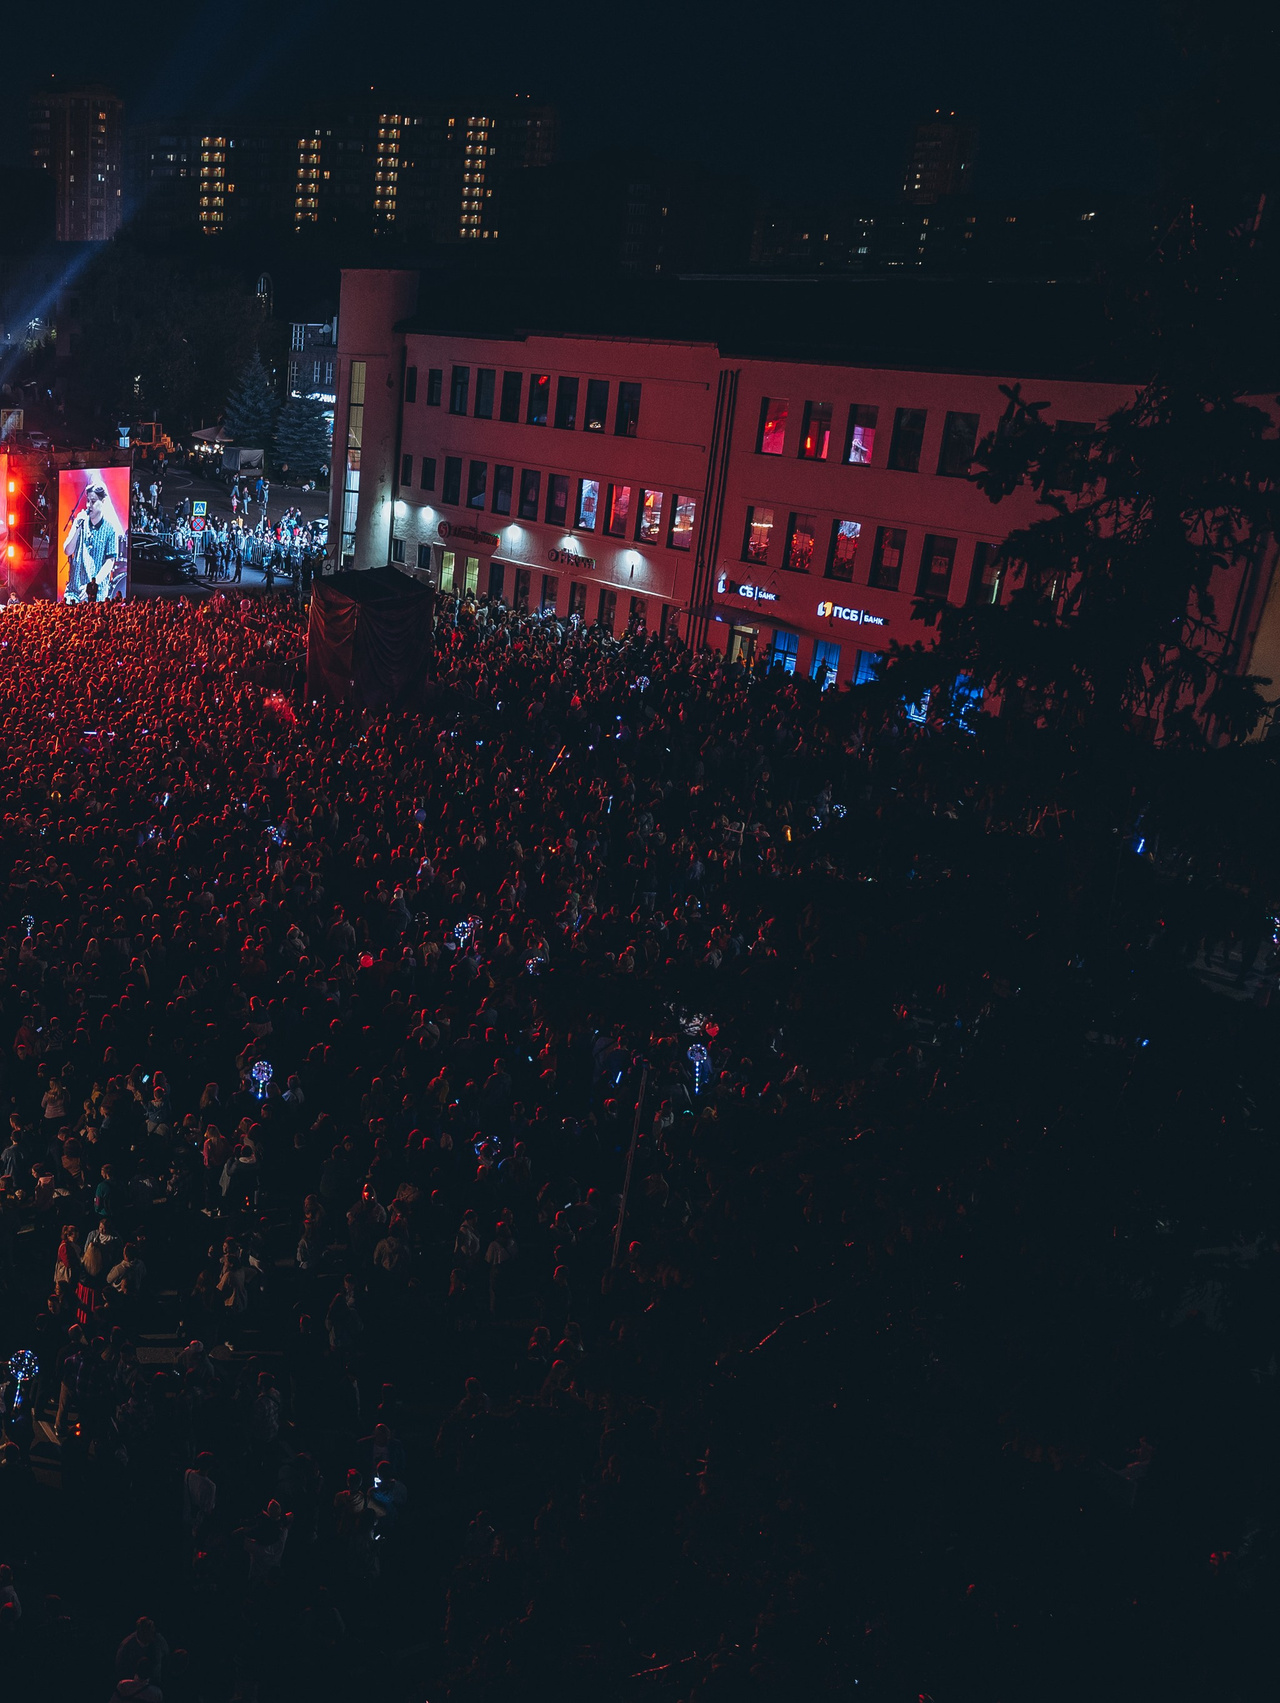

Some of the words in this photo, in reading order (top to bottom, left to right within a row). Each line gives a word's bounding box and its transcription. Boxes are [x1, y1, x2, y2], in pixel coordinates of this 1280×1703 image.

[758, 591, 776, 601] БАНК
[833, 605, 859, 622] ПСБ
[863, 614, 884, 626] БАНК
